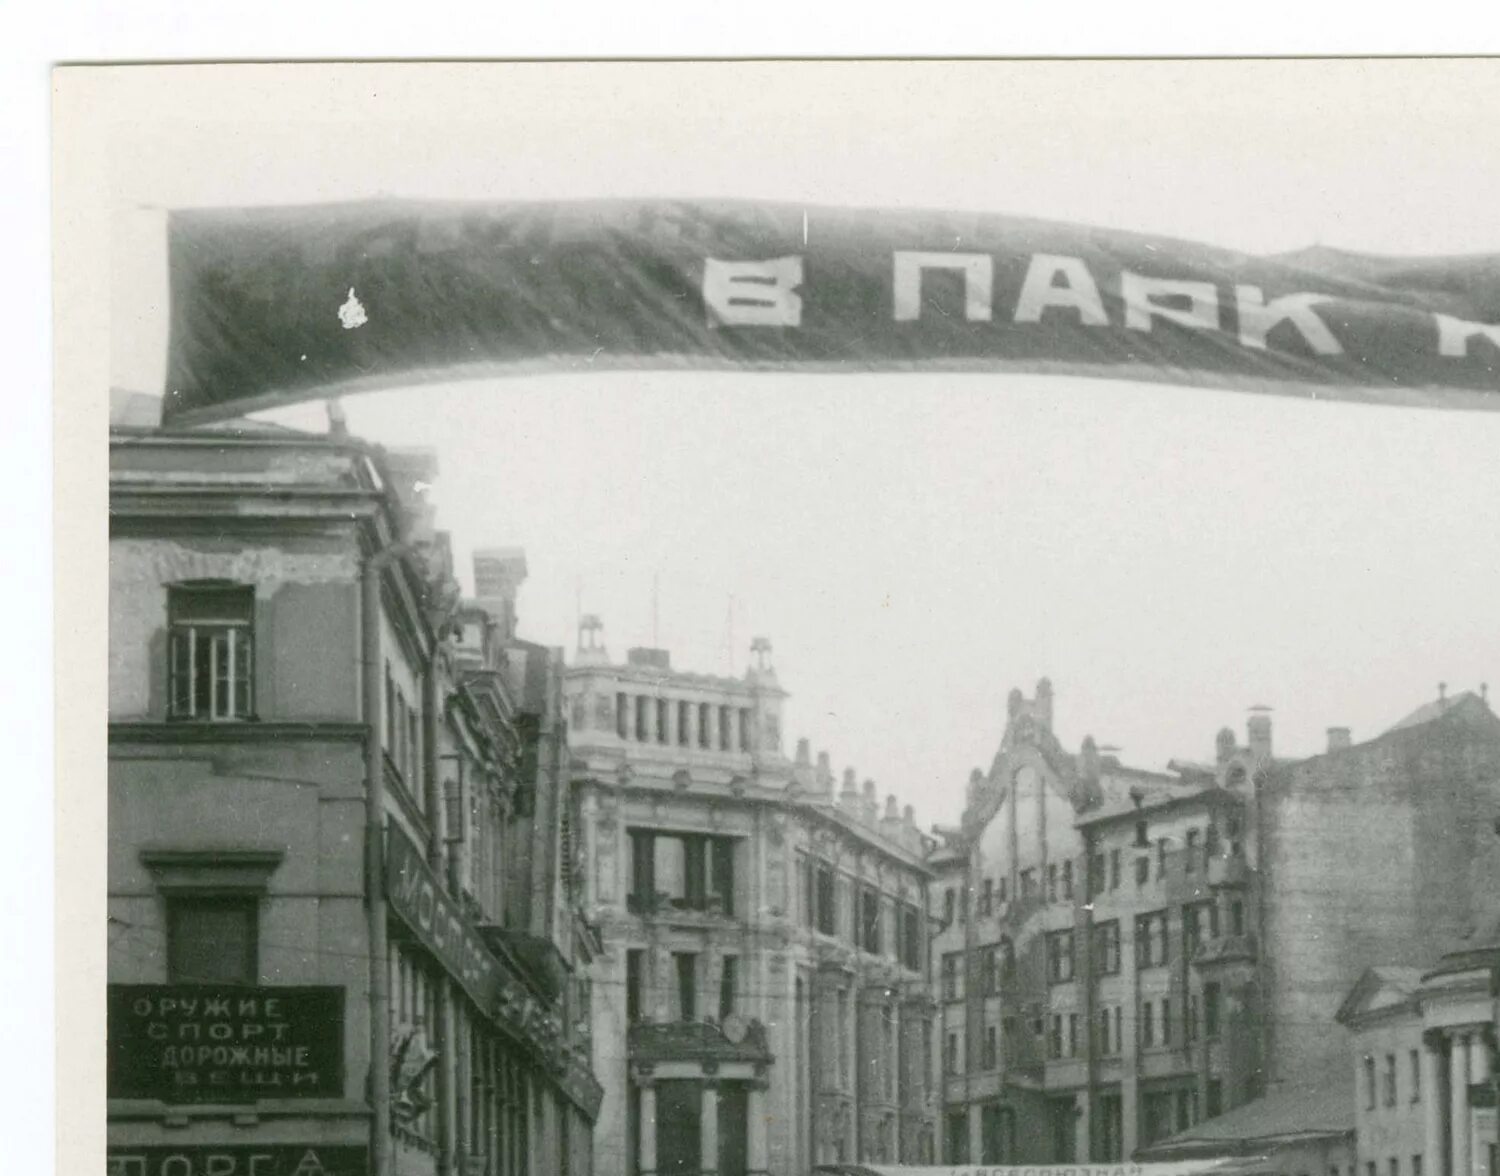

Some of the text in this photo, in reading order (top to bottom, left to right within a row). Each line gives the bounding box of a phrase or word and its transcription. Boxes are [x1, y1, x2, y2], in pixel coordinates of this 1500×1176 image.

[703, 255, 802, 328] В
[893, 251, 1345, 355] ПАРК
[133, 997, 282, 1017] ОРУЖИЕ
[148, 1022, 290, 1040] СПОРТ
[162, 1045, 309, 1068] ДОРОЖНЫЕ
